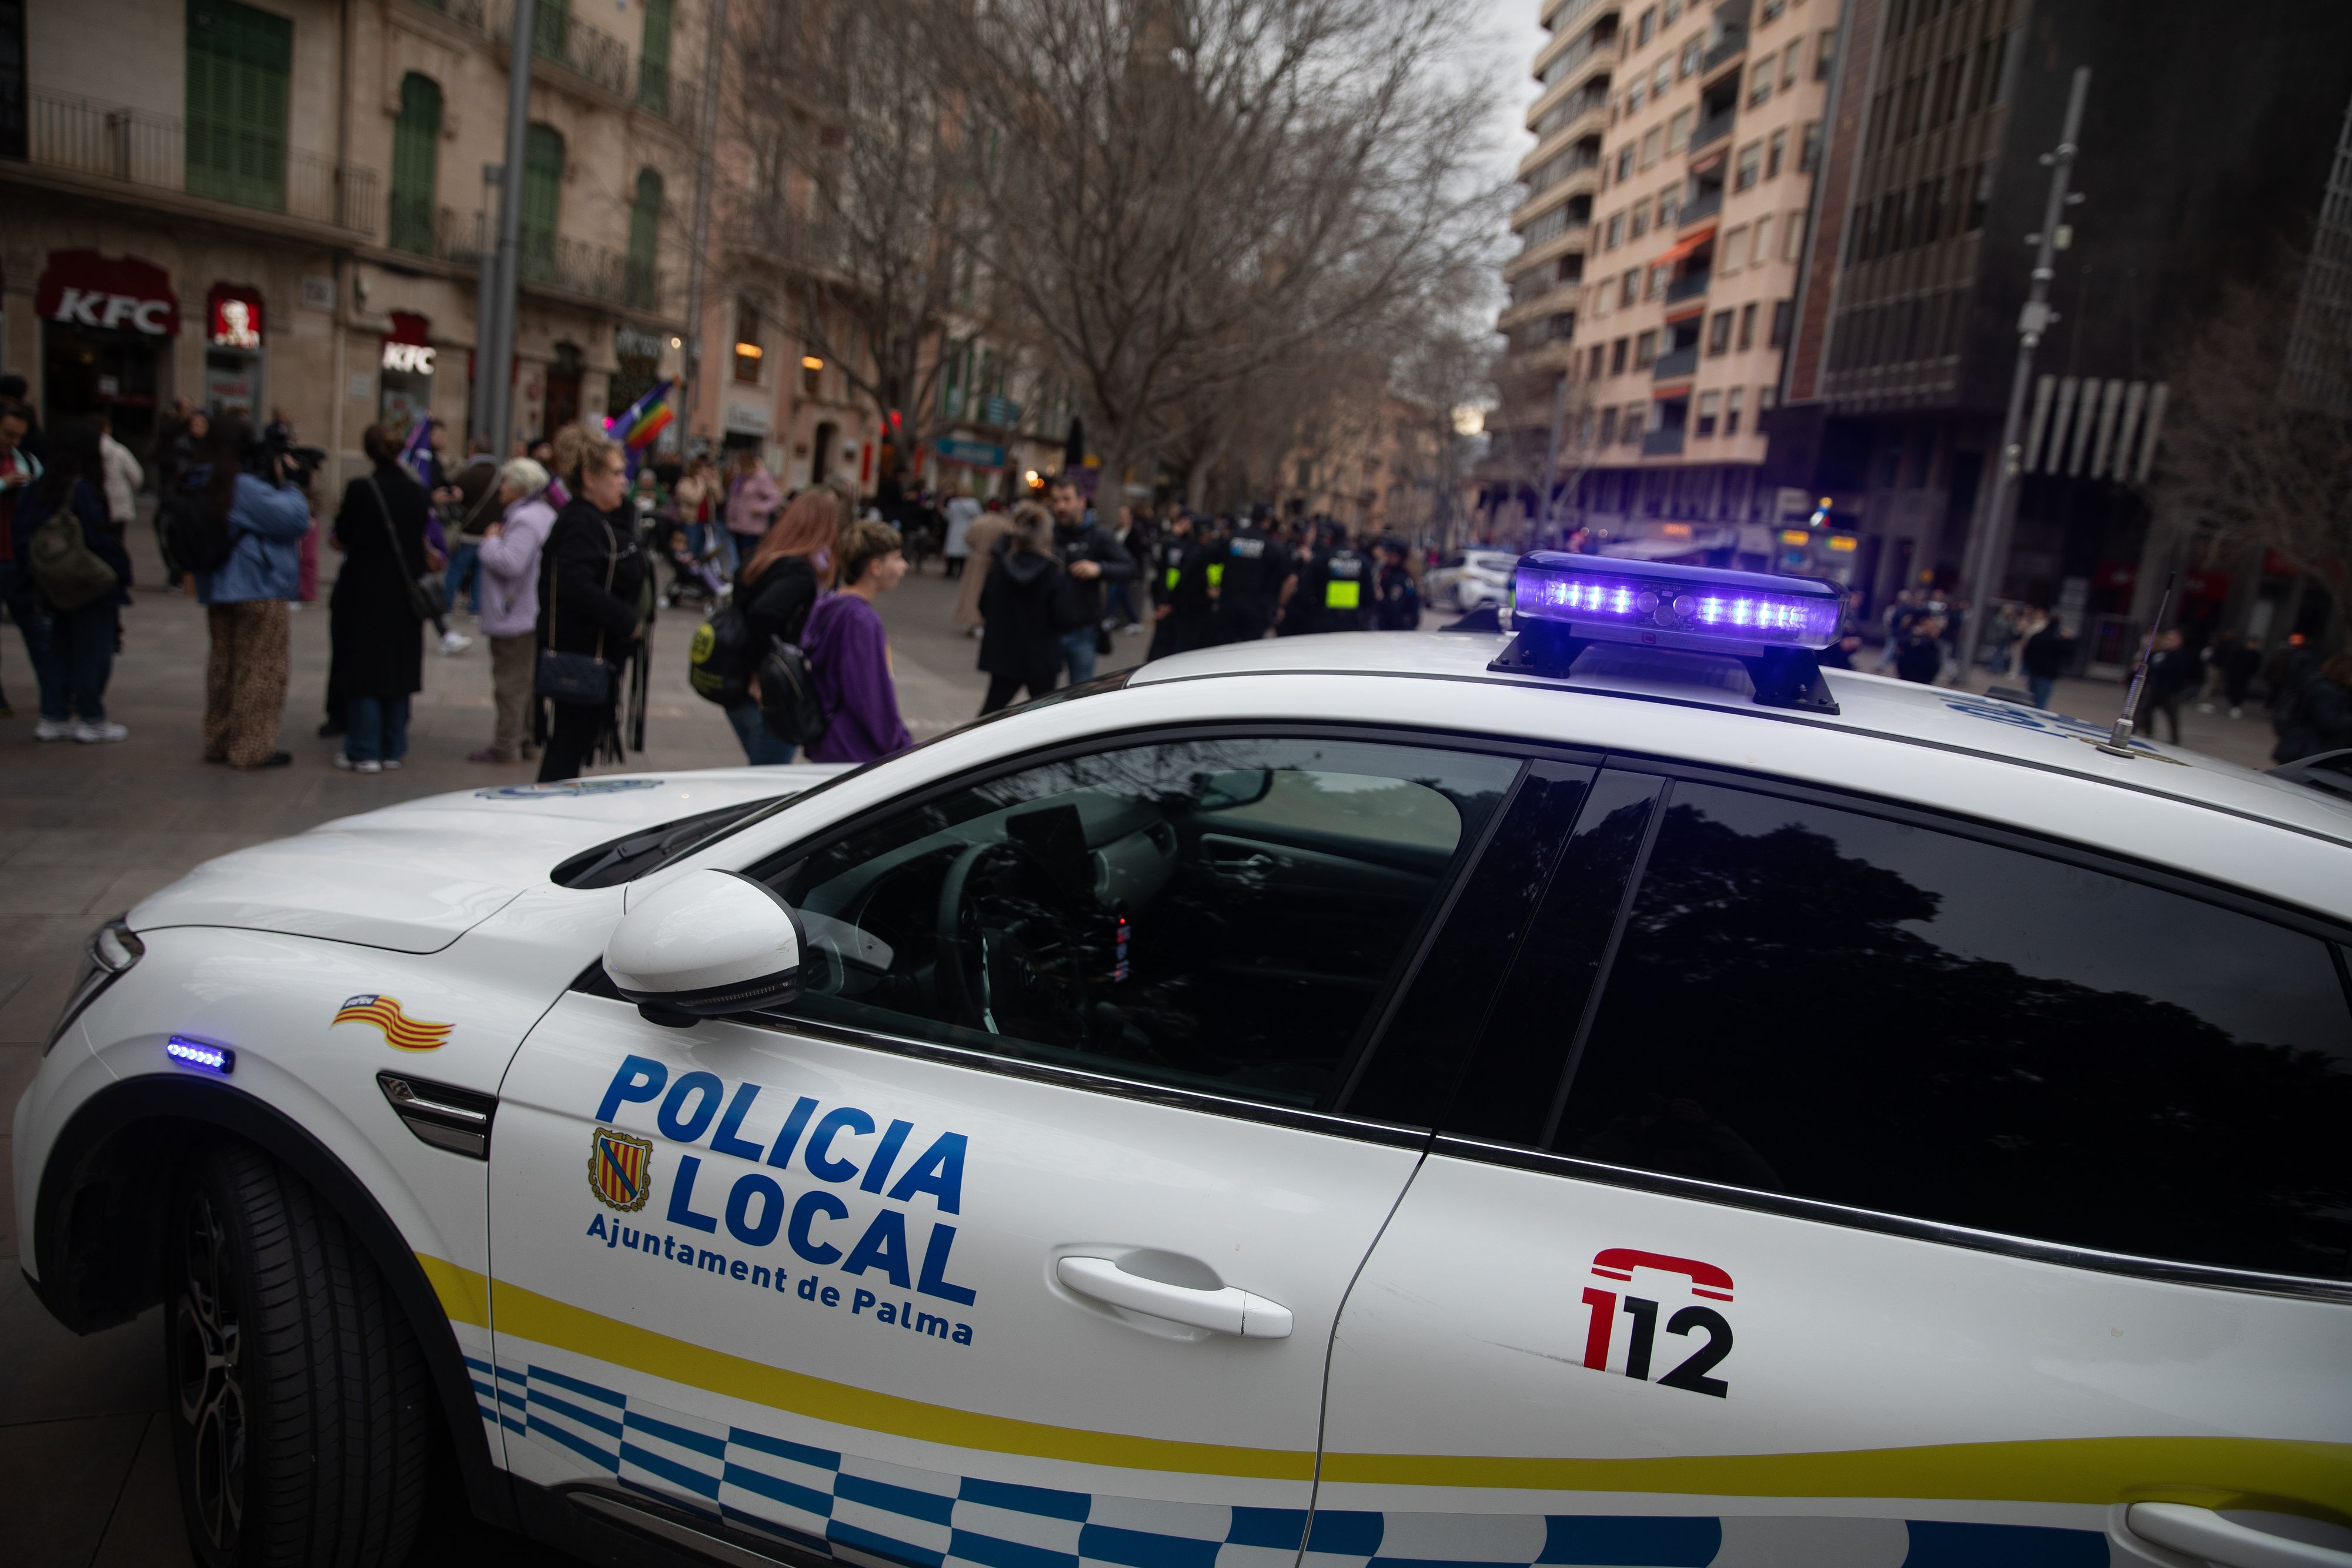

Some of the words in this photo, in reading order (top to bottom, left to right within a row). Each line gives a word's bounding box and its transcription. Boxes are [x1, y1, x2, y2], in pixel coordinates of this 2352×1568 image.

[55, 286, 172, 335] KFC
[382, 341, 437, 375] KFC
[595, 1054, 968, 1215] POLICIA
[586, 1213, 787, 1293] Ajuntament
[797, 1275, 840, 1308] de
[852, 1288, 973, 1346] Palma
[666, 1154, 977, 1306] LOCAL
[1582, 1286, 1733, 1399] 112
